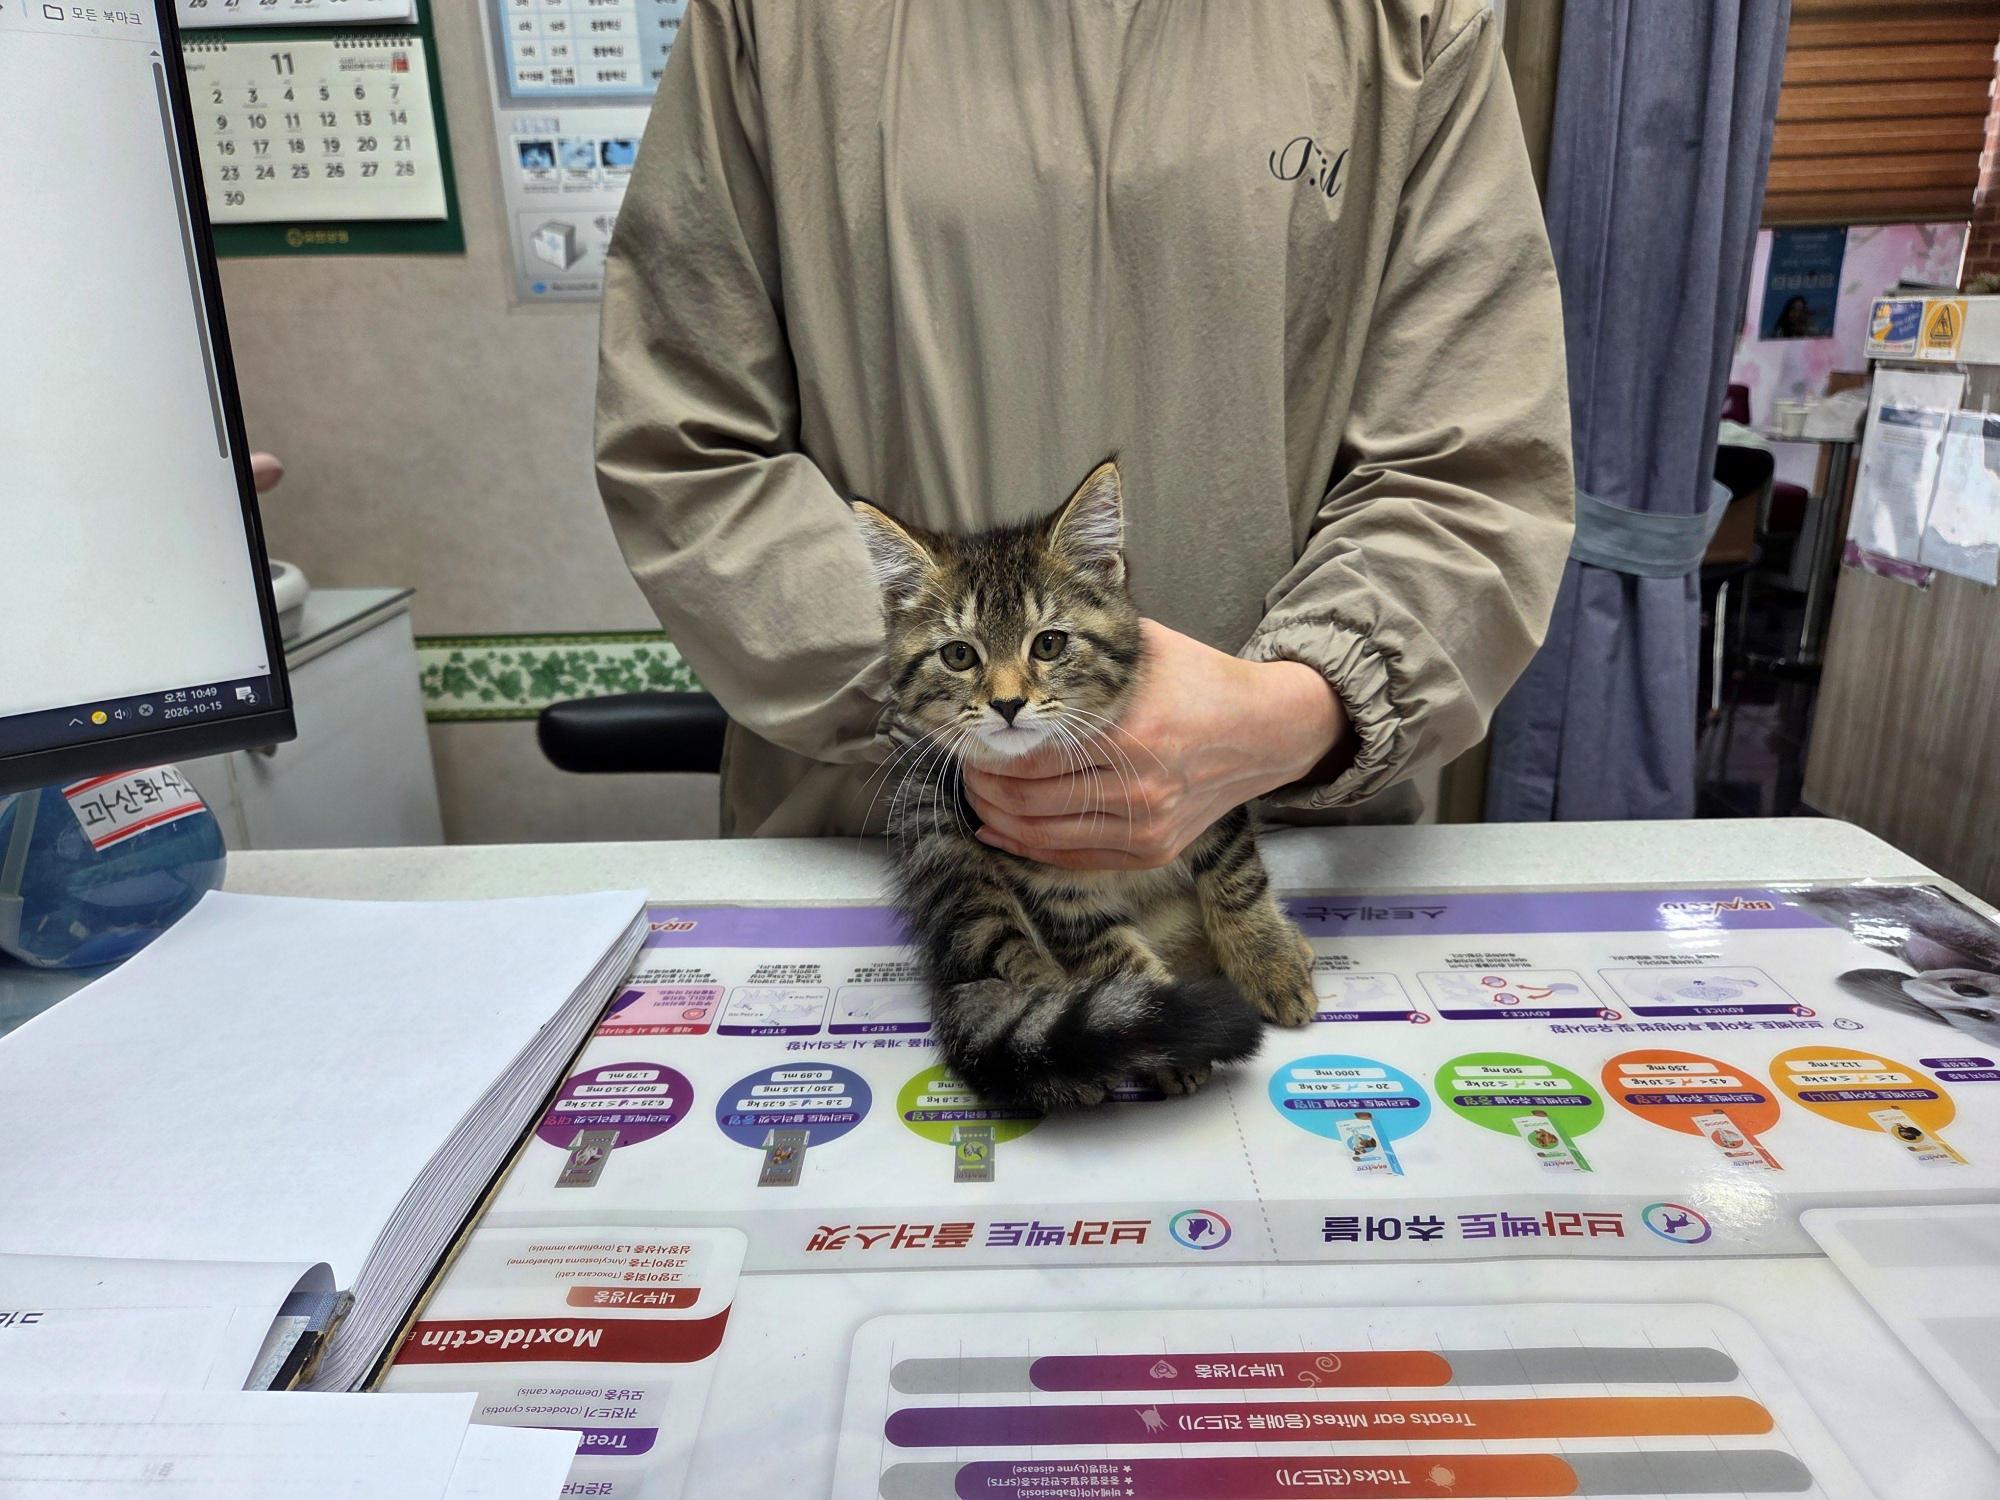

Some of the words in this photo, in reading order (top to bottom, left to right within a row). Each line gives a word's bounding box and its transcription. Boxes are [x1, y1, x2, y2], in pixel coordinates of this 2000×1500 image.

[72, 7, 98, 22] 모든
[103, 10, 142, 25] 북마크
[270, 52, 294, 75] 11
[212, 90, 223, 104] 2
[248, 87, 258, 103] 3
[284, 87, 294, 102] 4
[320, 87, 330, 101] 5
[355, 85, 365, 100] 6
[390, 86, 400, 99] 7
[216, 115, 228, 131] 9
[248, 114, 267, 129] 10
[285, 113, 301, 129] 11
[319, 112, 337, 127] 12
[354, 111, 372, 126] 13
[390, 111, 408, 125] 14
[217, 140, 235, 155] 16
[252, 139, 269, 155] 17
[288, 138, 305, 153] 18
[323, 137, 341, 153] 19
[357, 137, 378, 152] 20
[393, 136, 411, 151] 21
[221, 166, 240, 181] 23
[256, 165, 275, 180] 24
[291, 164, 310, 179] 25
[325, 163, 345, 178] 26
[360, 162, 380, 177] 27
[394, 161, 416, 176] 28
[224, 191, 245, 206] 30
[164, 691, 187, 704] 오전
[191, 687, 218, 700] 10:49
[164, 701, 223, 719] 2026-10-15
[1301, 905, 1447, 922] 스트레스는
[1511, 1009, 1550, 1018] ADVICE
[1706, 1006, 1744, 1014] ADVICE
[1320, 1012, 1359, 1021] ADVICE
[1704, 1021, 1753, 1033] 츄어블
[1757, 1020, 1824, 1032] 브라벡토
[786, 1040, 849, 1051] 주의사항
[852, 1039, 867, 1050] 시
[873, 1039, 902, 1049] 개봉
[908, 1038, 937, 1048] 제품
[1631, 1078, 1647, 1086] kg
[1801, 1074, 1817, 1083] kg
[1298, 1083, 1312, 1091] kg
[1465, 1080, 1480, 1088] kg
[926, 1096, 940, 1104] kg
[1532, 1096, 1582, 1105] 브라벡토
[1806, 1092, 1836, 1102] 미니
[564, 1100, 578, 1108] kg
[747, 1100, 760, 1108] kg
[1294, 1100, 1321, 1109] 대형
[1361, 1099, 1411, 1107] 브라벡토
[574, 1114, 622, 1124] 플러스캣
[624, 1114, 671, 1123] 브라벡토
[758, 1114, 804, 1124] 플러스캣
[807, 1113, 854, 1122] 브라벡토
[912, 1111, 939, 1121] 소형
[1321, 1215, 1446, 1243] 츄어블
[1456, 1210, 1625, 1240] 브라벡토
[805, 1222, 976, 1252] 플러스캣
[985, 1219, 1152, 1248] 브라벡토
[528, 1244, 566, 1253] immitis)
[567, 1244, 615, 1252] (Dirofilaria
[616, 1245, 631, 1253] L3
[634, 1245, 691, 1254] 심장사상충
[506, 1258, 563, 1266] tubaeforme)
[565, 1257, 627, 1266] (Ancylostoma
[628, 1259, 688, 1268] 고양이구충
[555, 1271, 576, 1280] cati)
[577, 1271, 622, 1280] (Toxocara
[623, 1272, 683, 1282] 고양이회충
[592, 1291, 675, 1304] 내부기생충
[420, 1328, 603, 1352] Moxidectin
[1194, 1362, 1284, 1379] 내부기생충
[517, 1388, 548, 1397] canis)
[549, 1388, 603, 1398] (Demodex
[604, 1390, 645, 1400] 모낭충
[482, 1404, 524, 1415] cynotis)
[525, 1405, 583, 1415] (Otodectes
[583, 1407, 638, 1419] 귀진드기
[1177, 1414, 1243, 1431] 진드기)
[1373, 1413, 1405, 1425] ear
[1409, 1413, 1477, 1427] Treats
[1012, 1465, 1055, 1475] disease)
[1057, 1464, 1119, 1474] 라임병(Lyme
[1017, 1488, 1121, 1498] 바베시아(Babesiosis)
